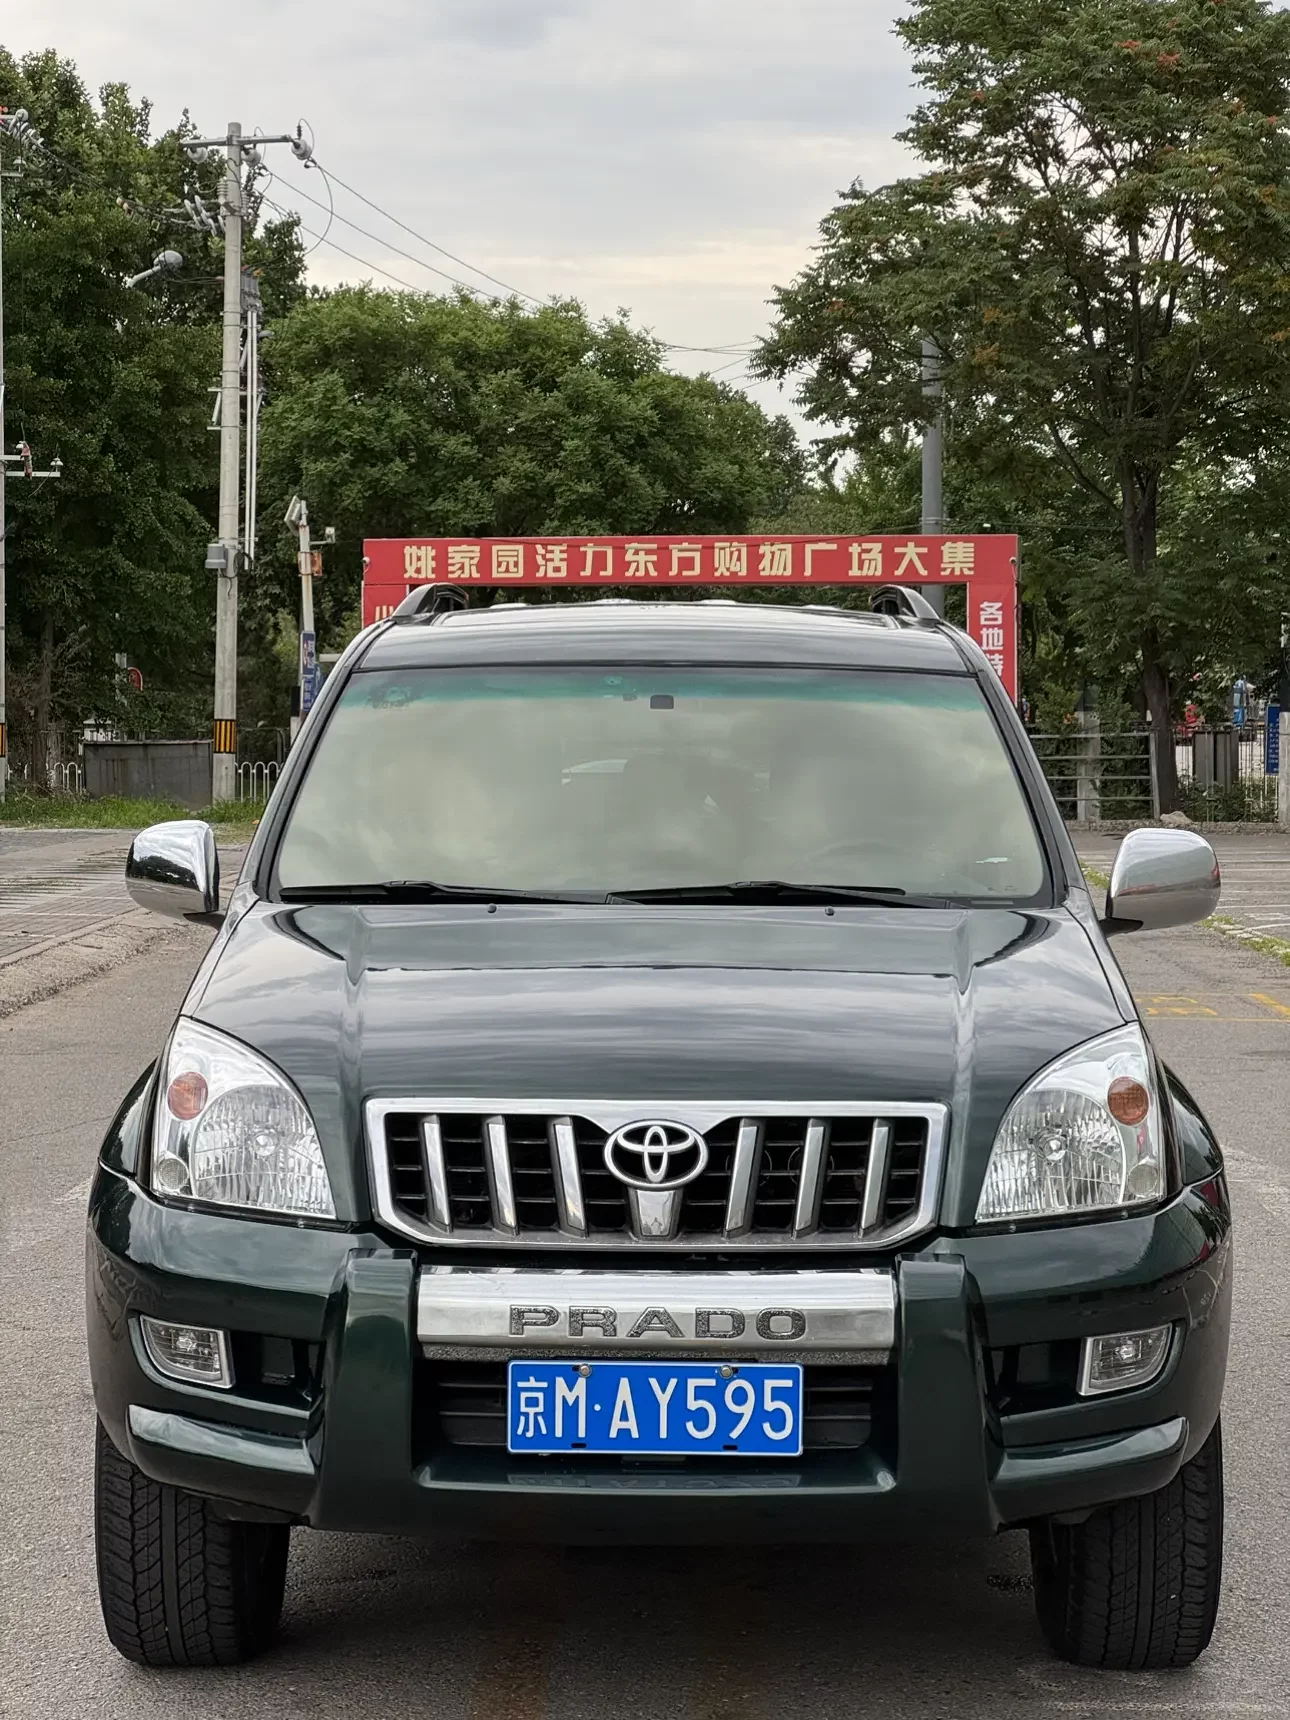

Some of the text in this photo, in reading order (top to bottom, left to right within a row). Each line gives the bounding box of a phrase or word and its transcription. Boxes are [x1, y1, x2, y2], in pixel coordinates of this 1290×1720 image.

[404, 541, 975, 579] 姚家园活力东方购物广场大集
[509, 1304, 807, 1341] PRADO
